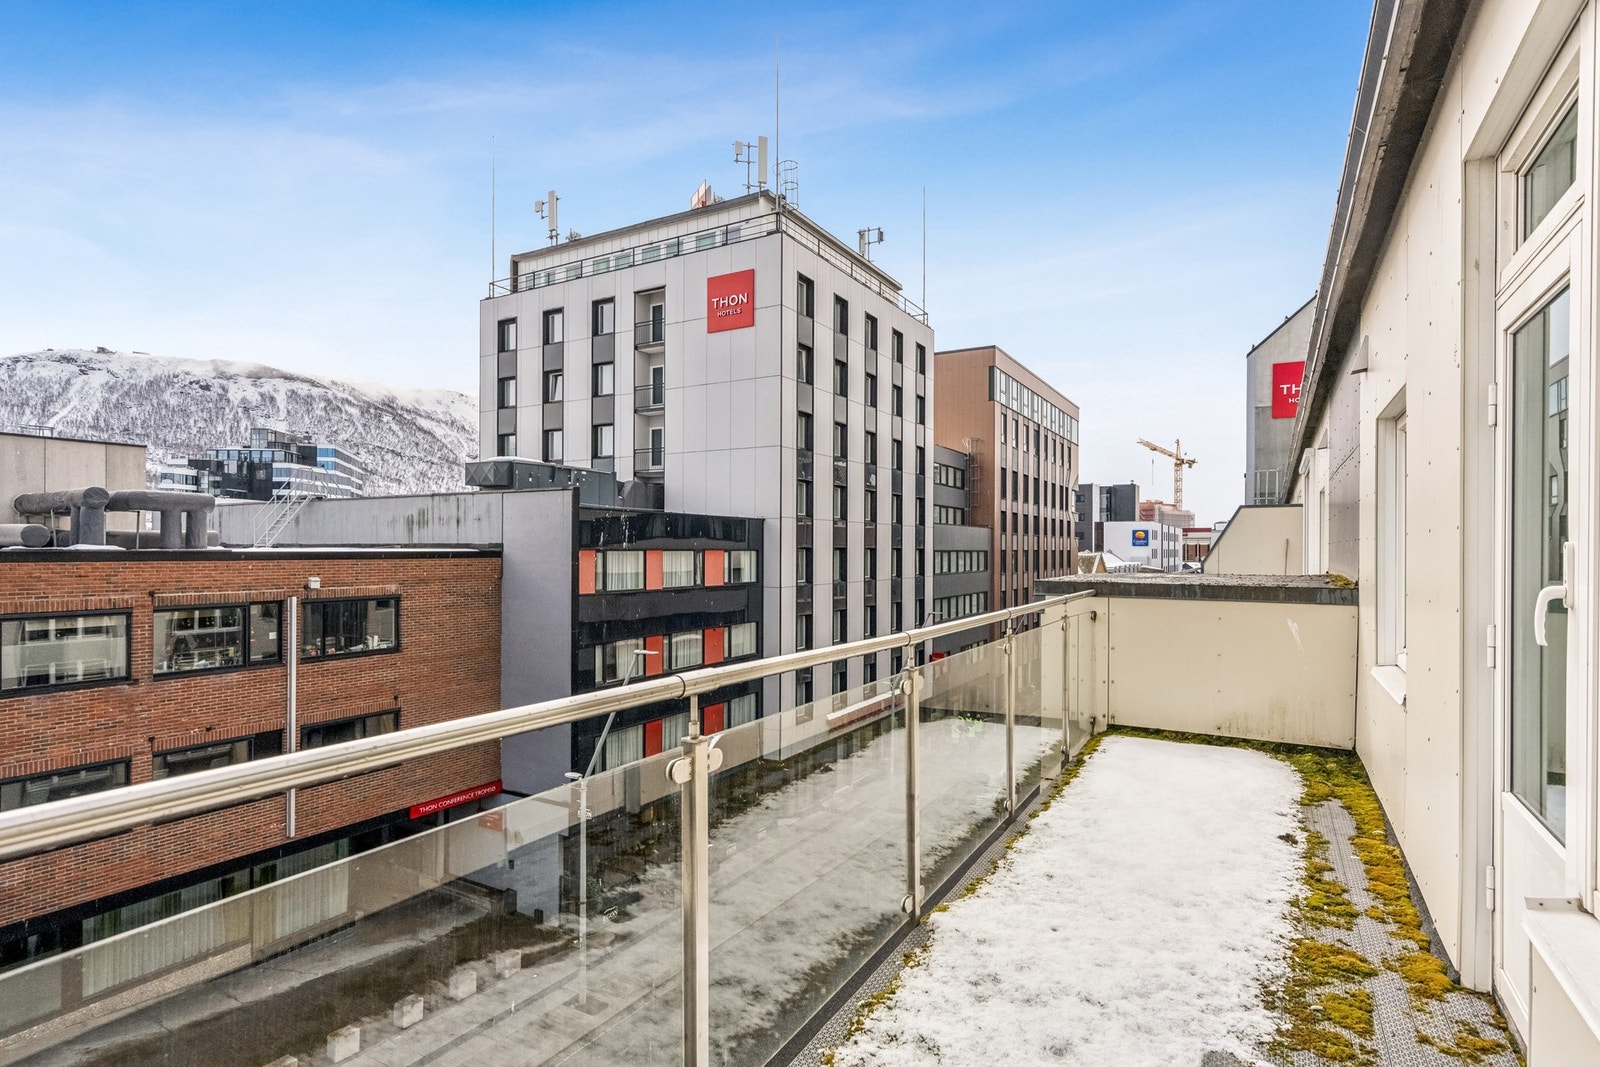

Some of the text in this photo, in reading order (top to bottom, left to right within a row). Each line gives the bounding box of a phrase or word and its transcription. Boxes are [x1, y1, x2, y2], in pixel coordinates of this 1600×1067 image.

[711, 292, 748, 309] THON
[717, 307, 742, 317] HOTELS
[1279, 384, 1302, 395] TH
[419, 803, 438, 813] THON
[438, 792, 474, 807] CONFERENCE
